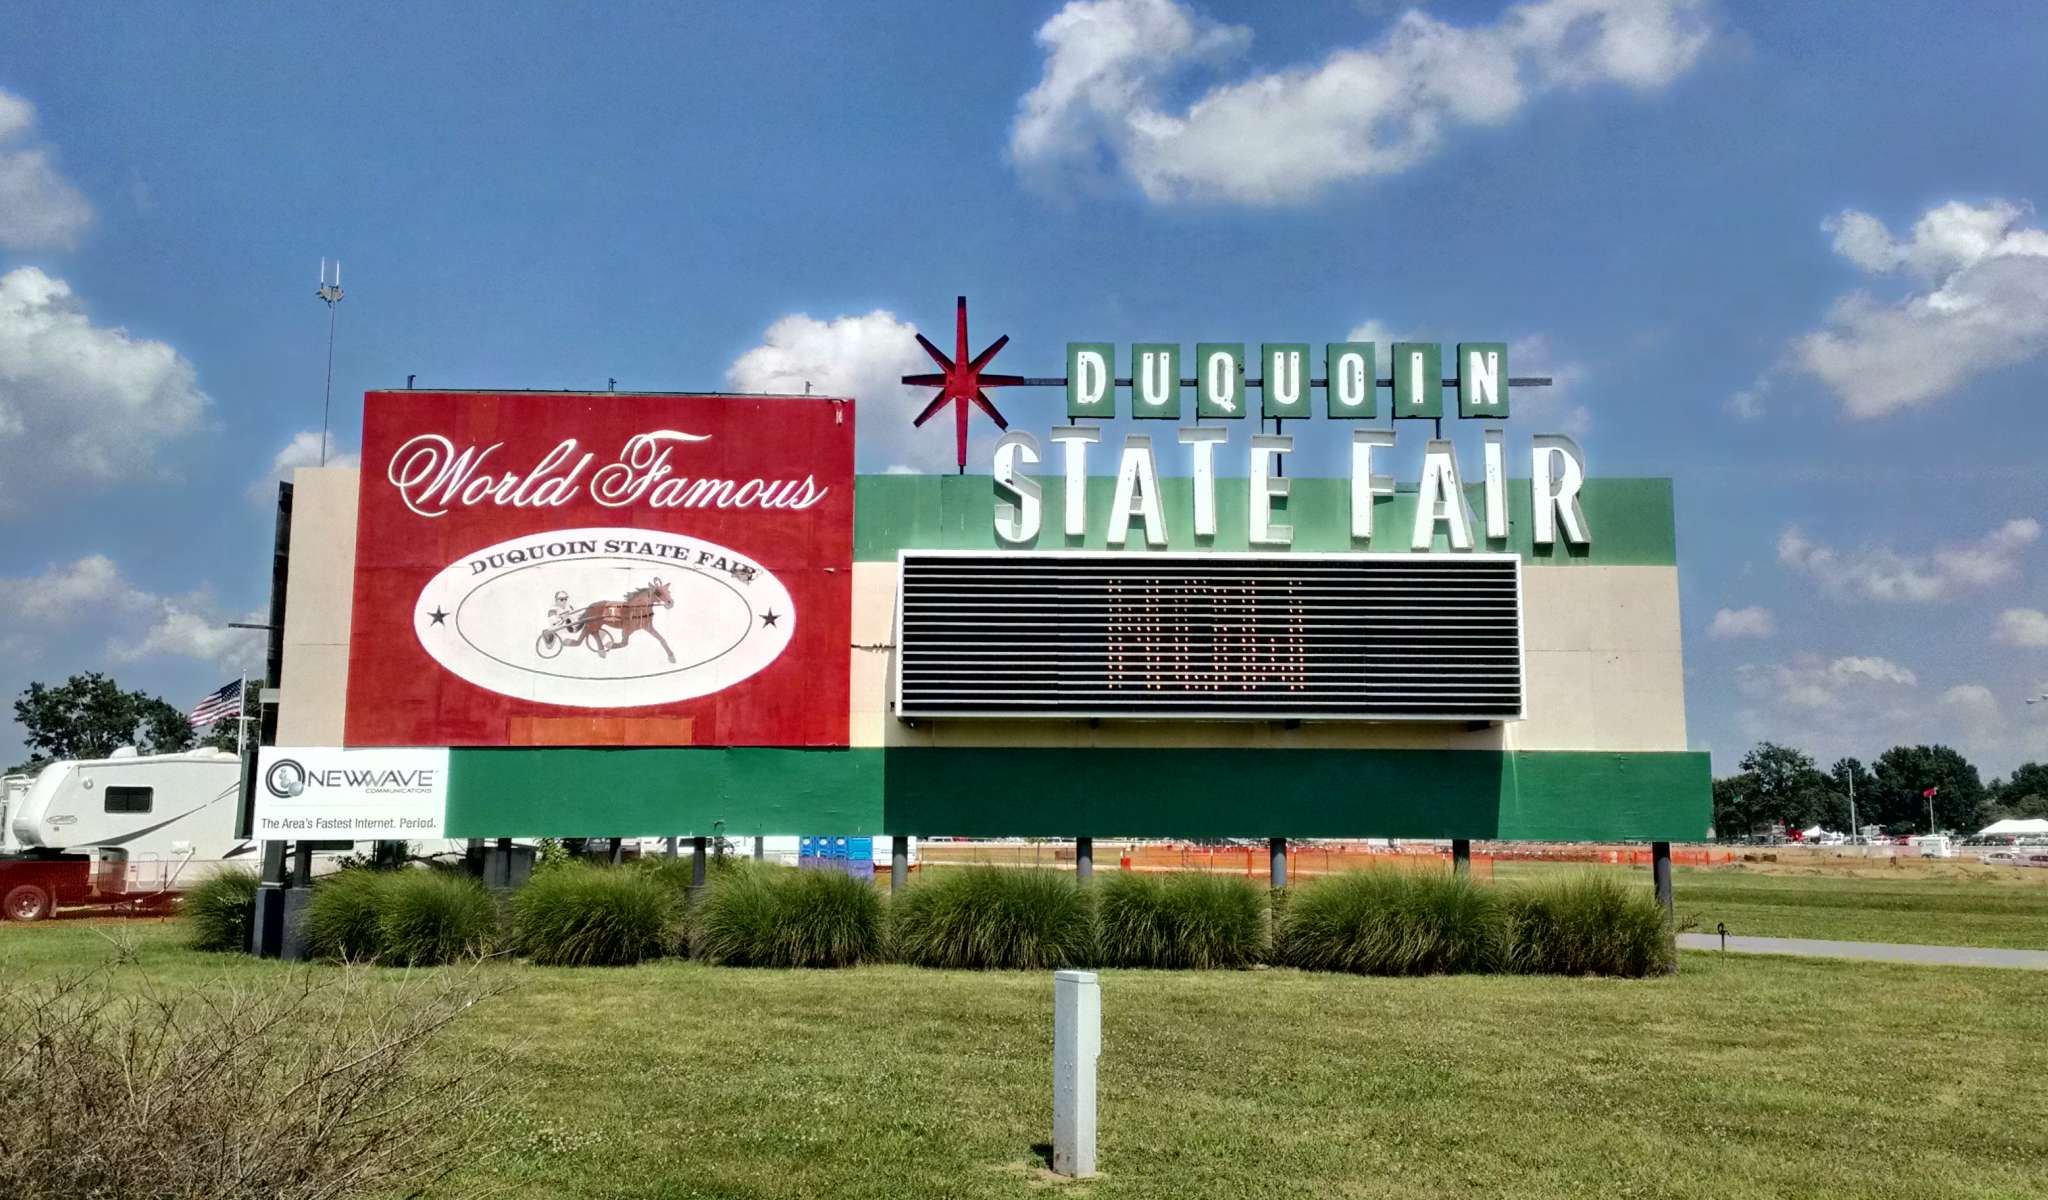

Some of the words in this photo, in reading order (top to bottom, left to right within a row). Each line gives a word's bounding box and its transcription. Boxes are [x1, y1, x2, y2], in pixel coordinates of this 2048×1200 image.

[1077, 350, 1499, 411] DUQUOIN
[387, 433, 594, 518] World
[590, 429, 828, 509] Famous
[993, 424, 1297, 549] STATE
[1349, 427, 1592, 550] FAIR
[469, 539, 599, 576] DUQUOIN
[604, 539, 690, 561] STATE
[261, 818, 280, 829] The
[281, 818, 313, 829] Area's
[316, 818, 352, 829] Fastest
[355, 818, 396, 829] Internet.
[400, 818, 437, 829] Period.
